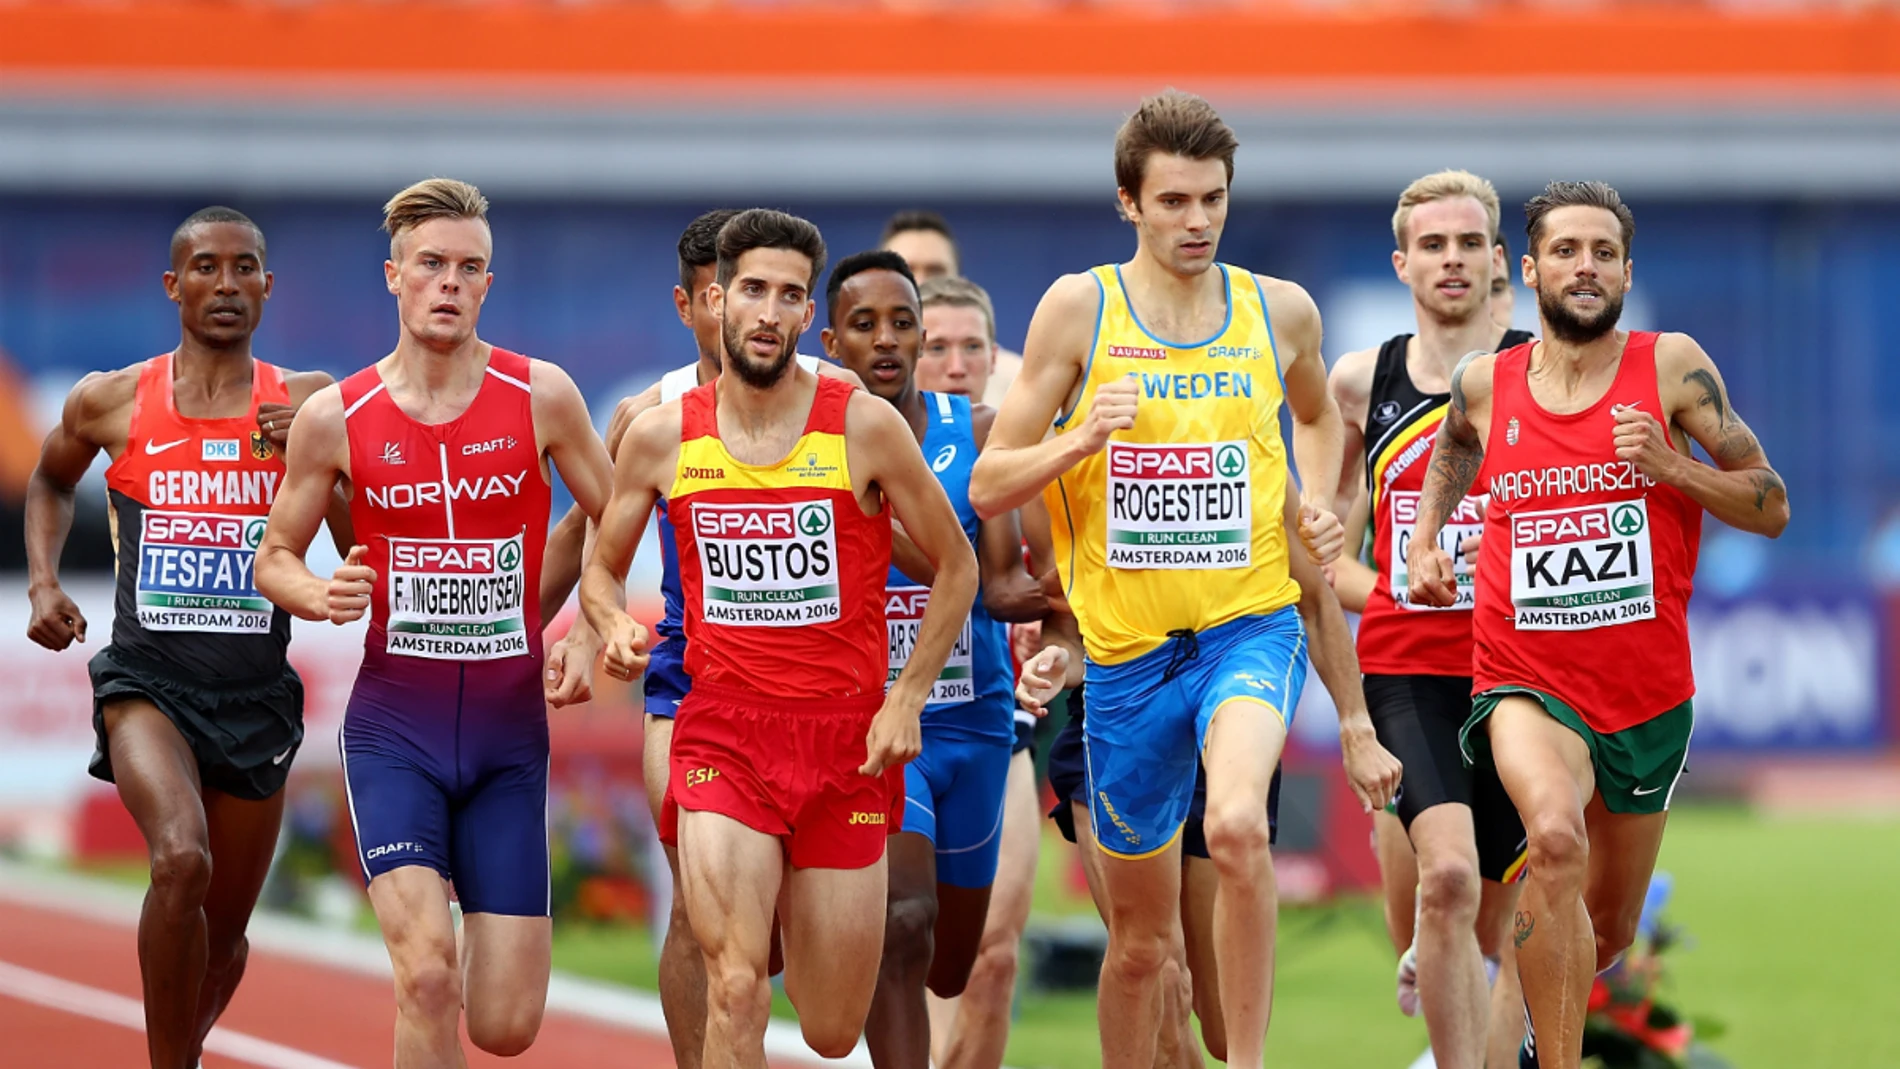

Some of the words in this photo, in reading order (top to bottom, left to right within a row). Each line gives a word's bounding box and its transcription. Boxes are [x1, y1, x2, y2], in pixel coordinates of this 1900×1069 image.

[1109, 346, 1166, 359] BAUHAUS
[1208, 346, 1251, 358] CRAFT
[1127, 371, 1252, 399] WEDEN
[205, 443, 237, 456] DKB
[462, 438, 505, 456] CRAFT
[1113, 451, 1211, 475] SPAR
[1384, 436, 1430, 484] BELGIUM
[149, 470, 277, 506] GERMANY
[365, 470, 528, 509] NORWAY
[1114, 482, 1246, 521] ROGESTEDT
[147, 517, 240, 543] SPAR
[698, 512, 792, 535] SPAR
[1516, 512, 1607, 543] SPAR
[1140, 533, 1144, 543] I
[1147, 533, 1175, 543] RUN
[1178, 532, 1217, 543] CLEAN
[395, 546, 492, 569] SPAR
[705, 540, 831, 581] BUSTOS
[1110, 550, 1212, 563] AMSTERDAM
[1217, 548, 1247, 562] 2016
[1526, 540, 1639, 588] KAZI
[147, 548, 256, 590] TESFAY
[167, 597, 172, 606] I
[175, 597, 200, 608] RUN
[202, 598, 240, 609] CLEAN
[731, 592, 735, 600] I
[737, 593, 762, 602] RUN
[766, 590, 804, 601] CLEAN
[1553, 596, 1579, 606] RUN
[1581, 590, 1620, 603] CLEAN
[140, 611, 232, 627] AMSTERDAM
[237, 615, 268, 628] 2016
[707, 605, 800, 621] AMSTERDAM
[806, 602, 838, 618] 2016
[1518, 607, 1616, 625] AMSTERDAM
[1621, 601, 1651, 618] 2016
[430, 624, 455, 634] RUN
[458, 625, 495, 635] CLEAN
[391, 637, 491, 654] AMSTERDAM
[496, 637, 524, 650] 2016
[941, 684, 970, 698] 2016
[686, 767, 720, 788] ESP
[1099, 791, 1134, 835] CRAFT
[367, 842, 413, 860] CRAFT
